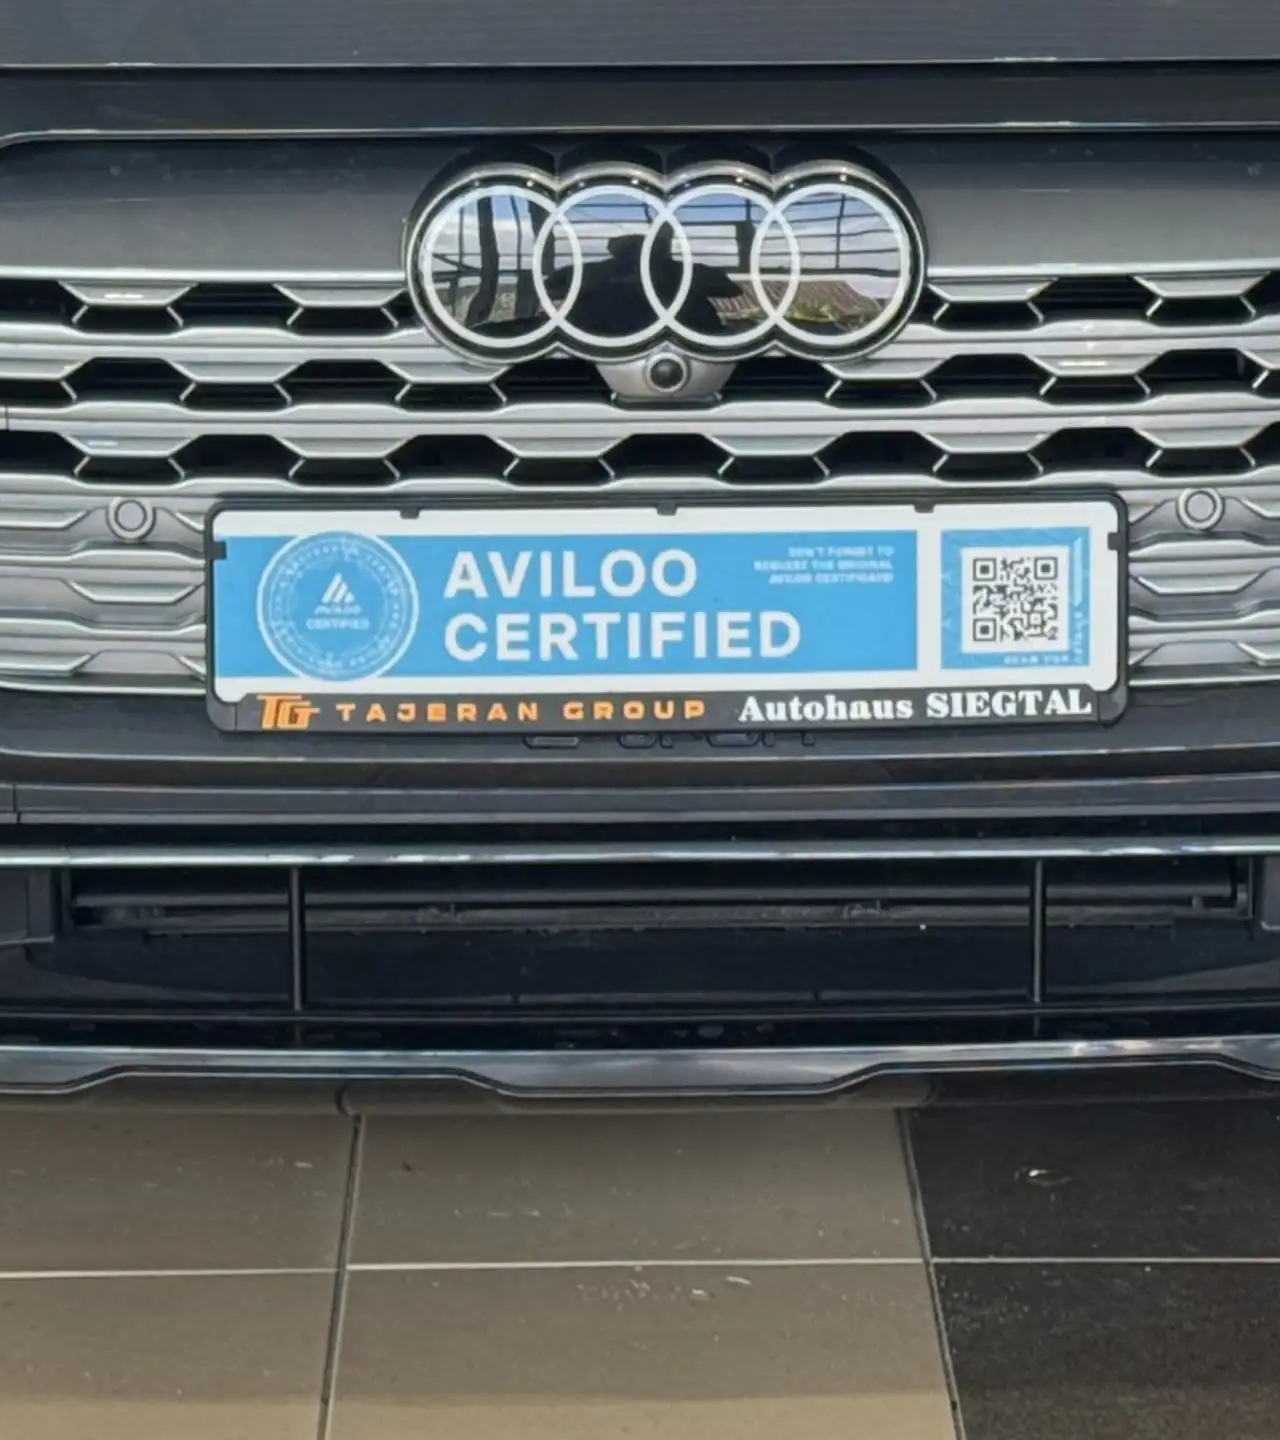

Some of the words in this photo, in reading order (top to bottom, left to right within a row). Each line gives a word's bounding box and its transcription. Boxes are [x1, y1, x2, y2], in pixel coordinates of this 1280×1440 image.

[443, 548, 697, 598] AVILOO
[444, 610, 801, 660] CERTIFIED
[335, 701, 539, 723] TAJERAN
[562, 699, 706, 720] GROUP
[741, 693, 913, 722] Autohaus
[926, 688, 1092, 718] SIEGTAL
